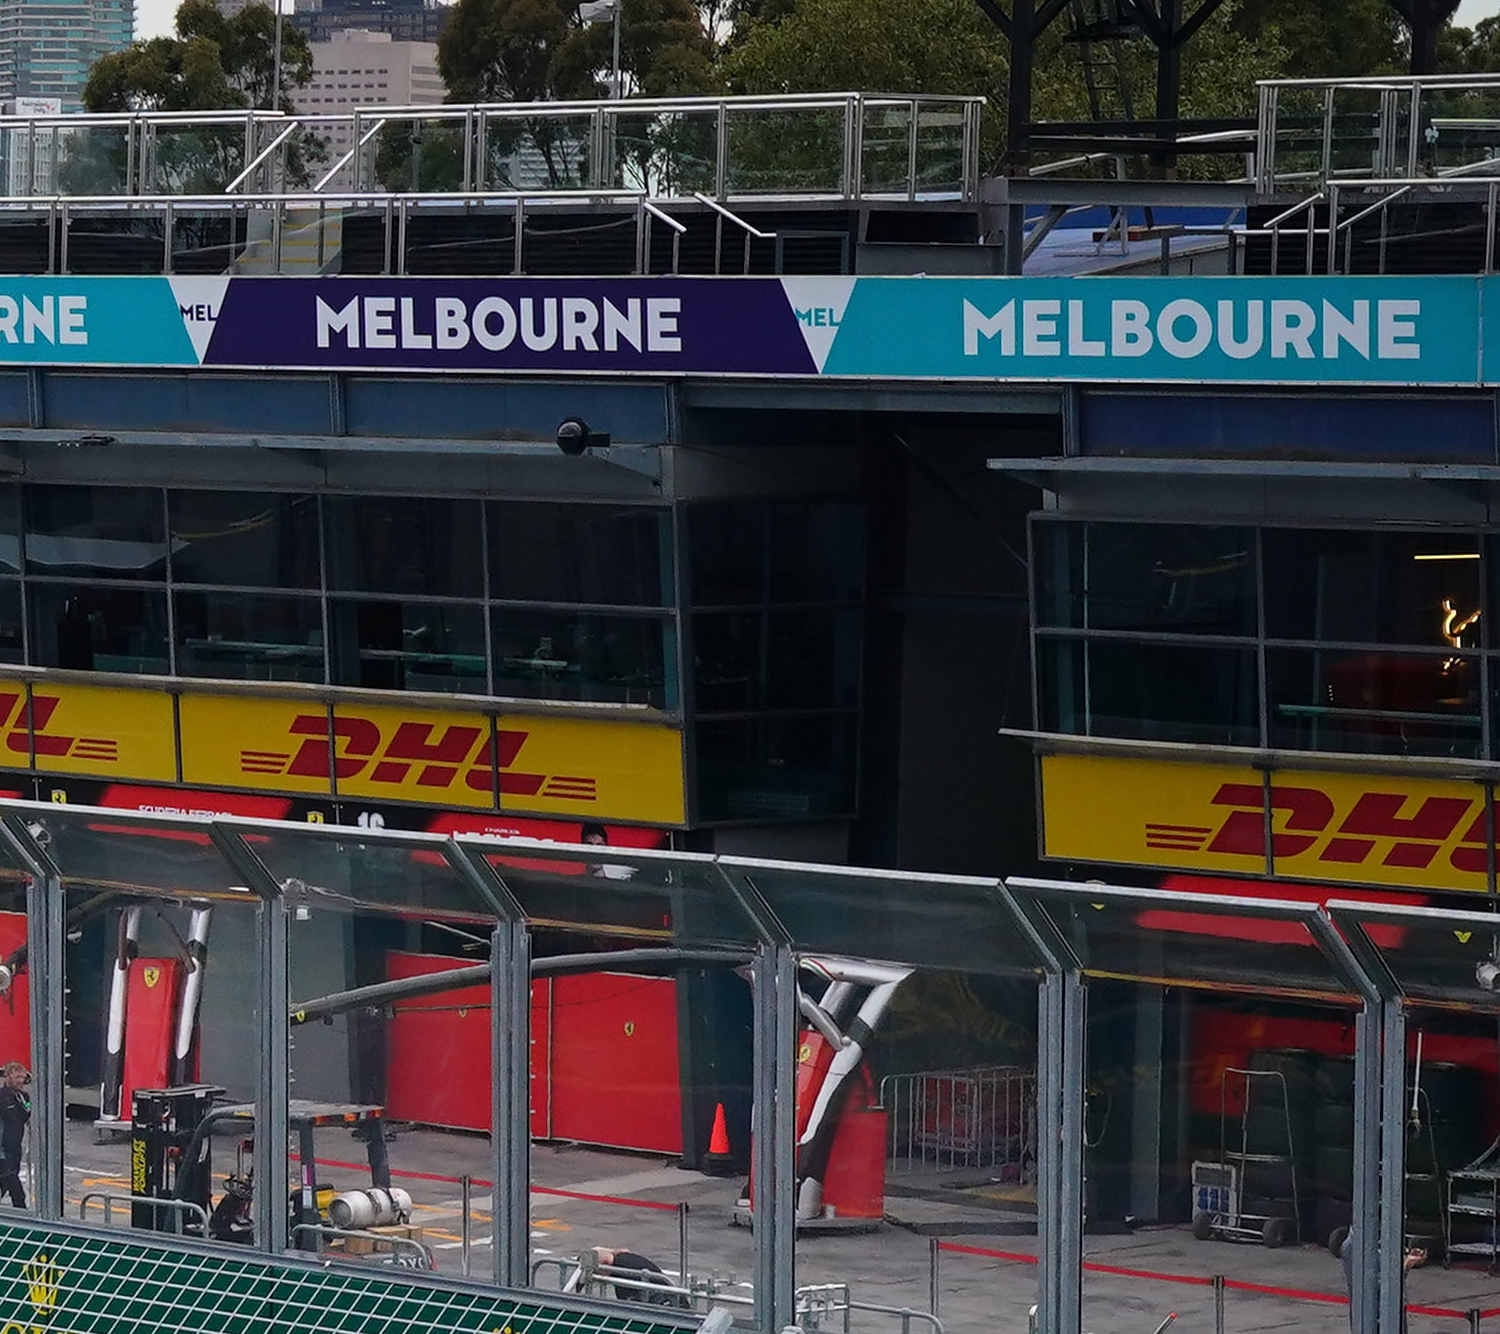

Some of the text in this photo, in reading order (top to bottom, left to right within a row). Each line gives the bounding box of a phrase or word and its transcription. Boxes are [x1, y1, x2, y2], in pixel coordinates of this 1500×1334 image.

[316, 296, 681, 352] MELBOURNE
[964, 299, 1420, 360] MELBOURNE
[287, 715, 553, 796] DHL
